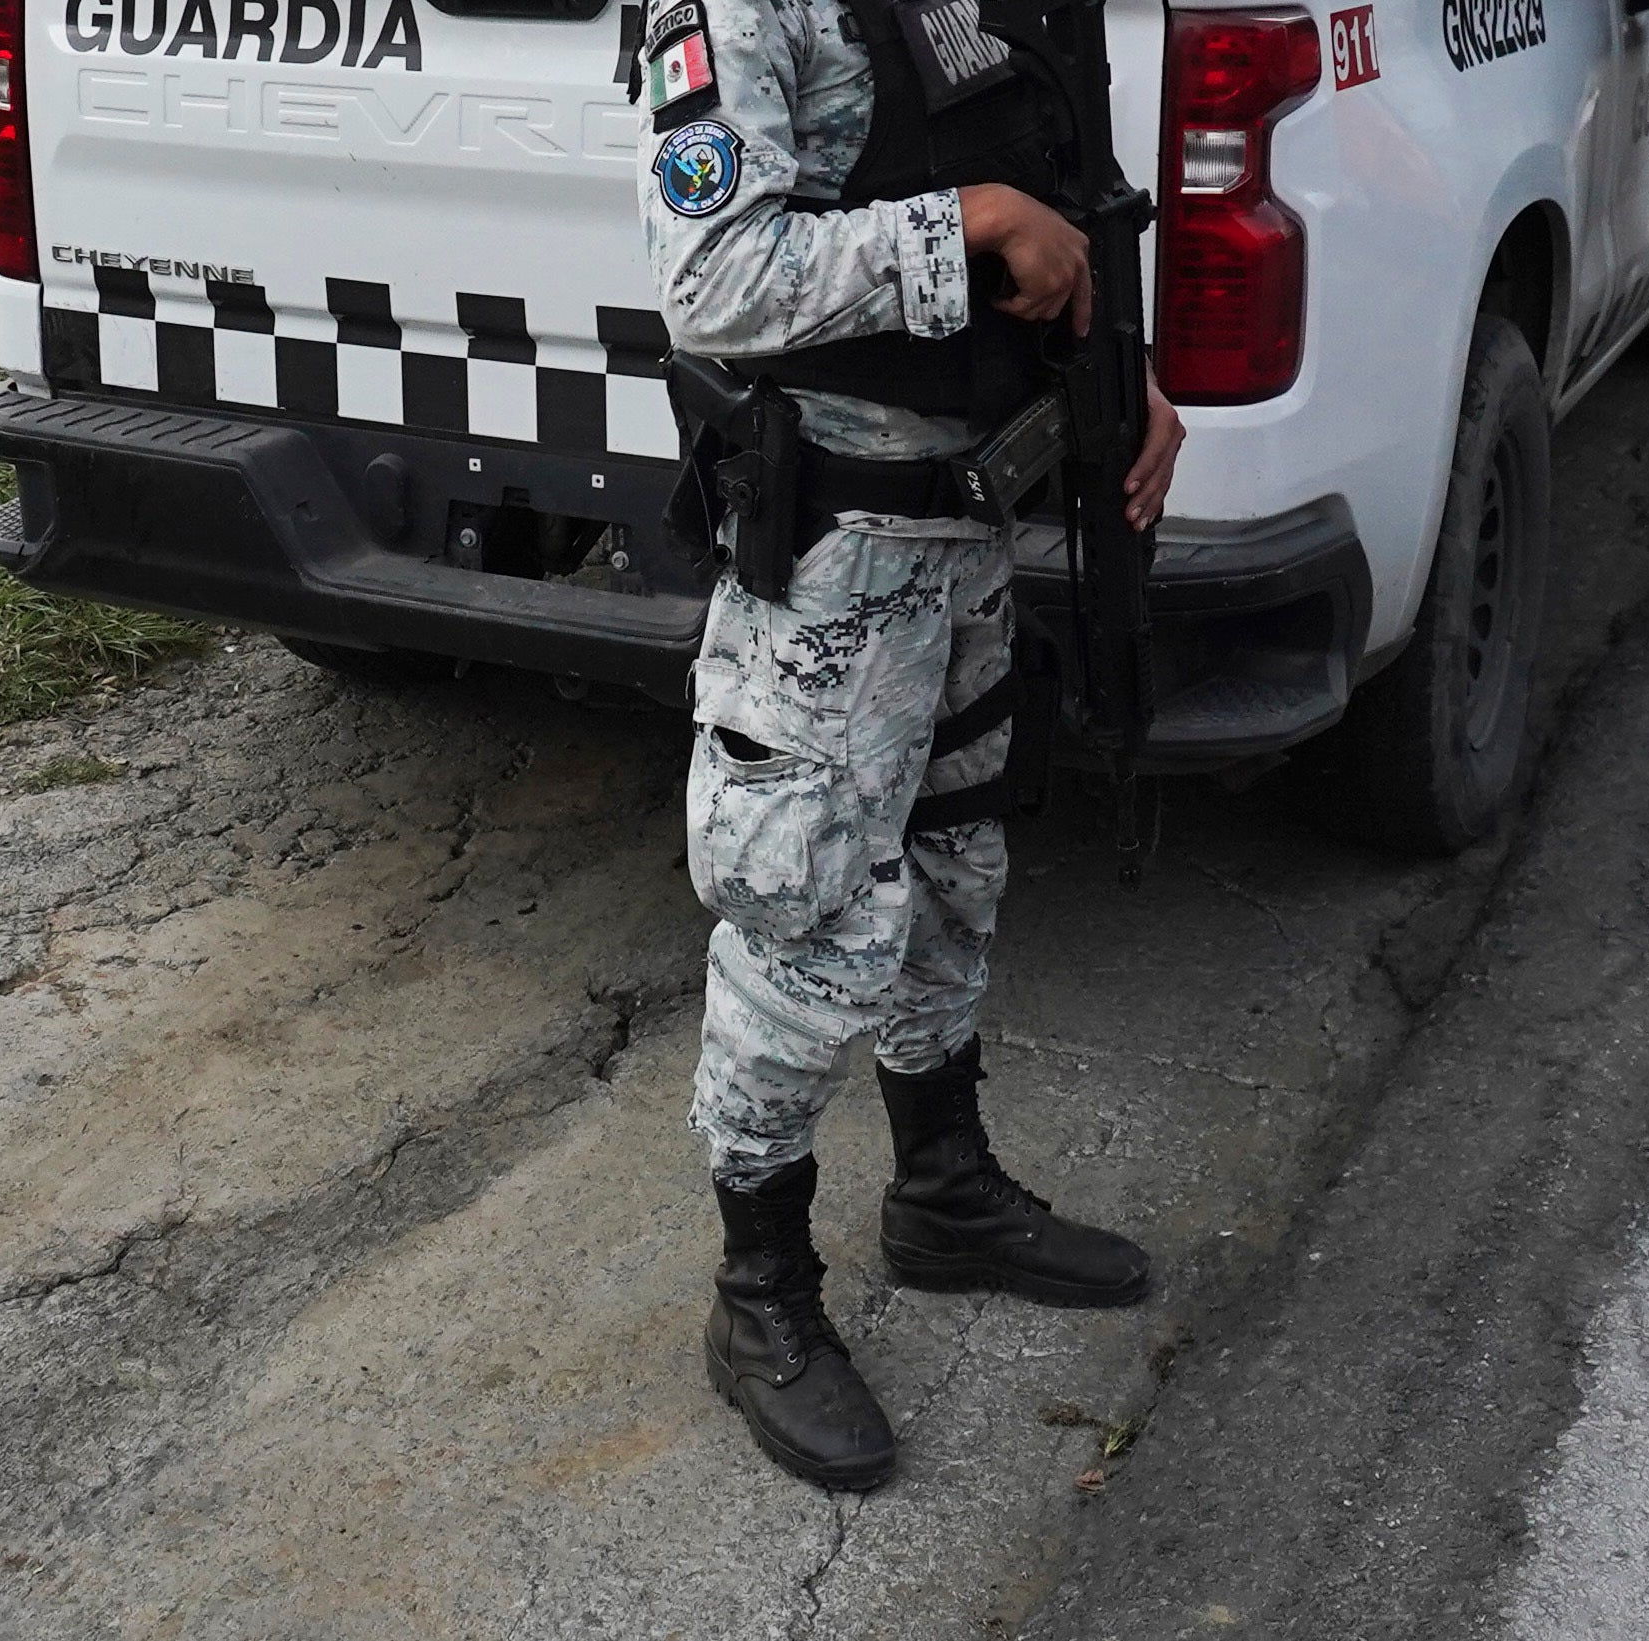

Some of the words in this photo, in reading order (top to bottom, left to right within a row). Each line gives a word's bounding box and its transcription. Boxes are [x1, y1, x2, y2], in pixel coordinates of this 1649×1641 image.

[645, 7, 694, 53] MEXICO
[1333, 11, 1378, 82] 911
[51, 243, 255, 285] CHEYENNE
